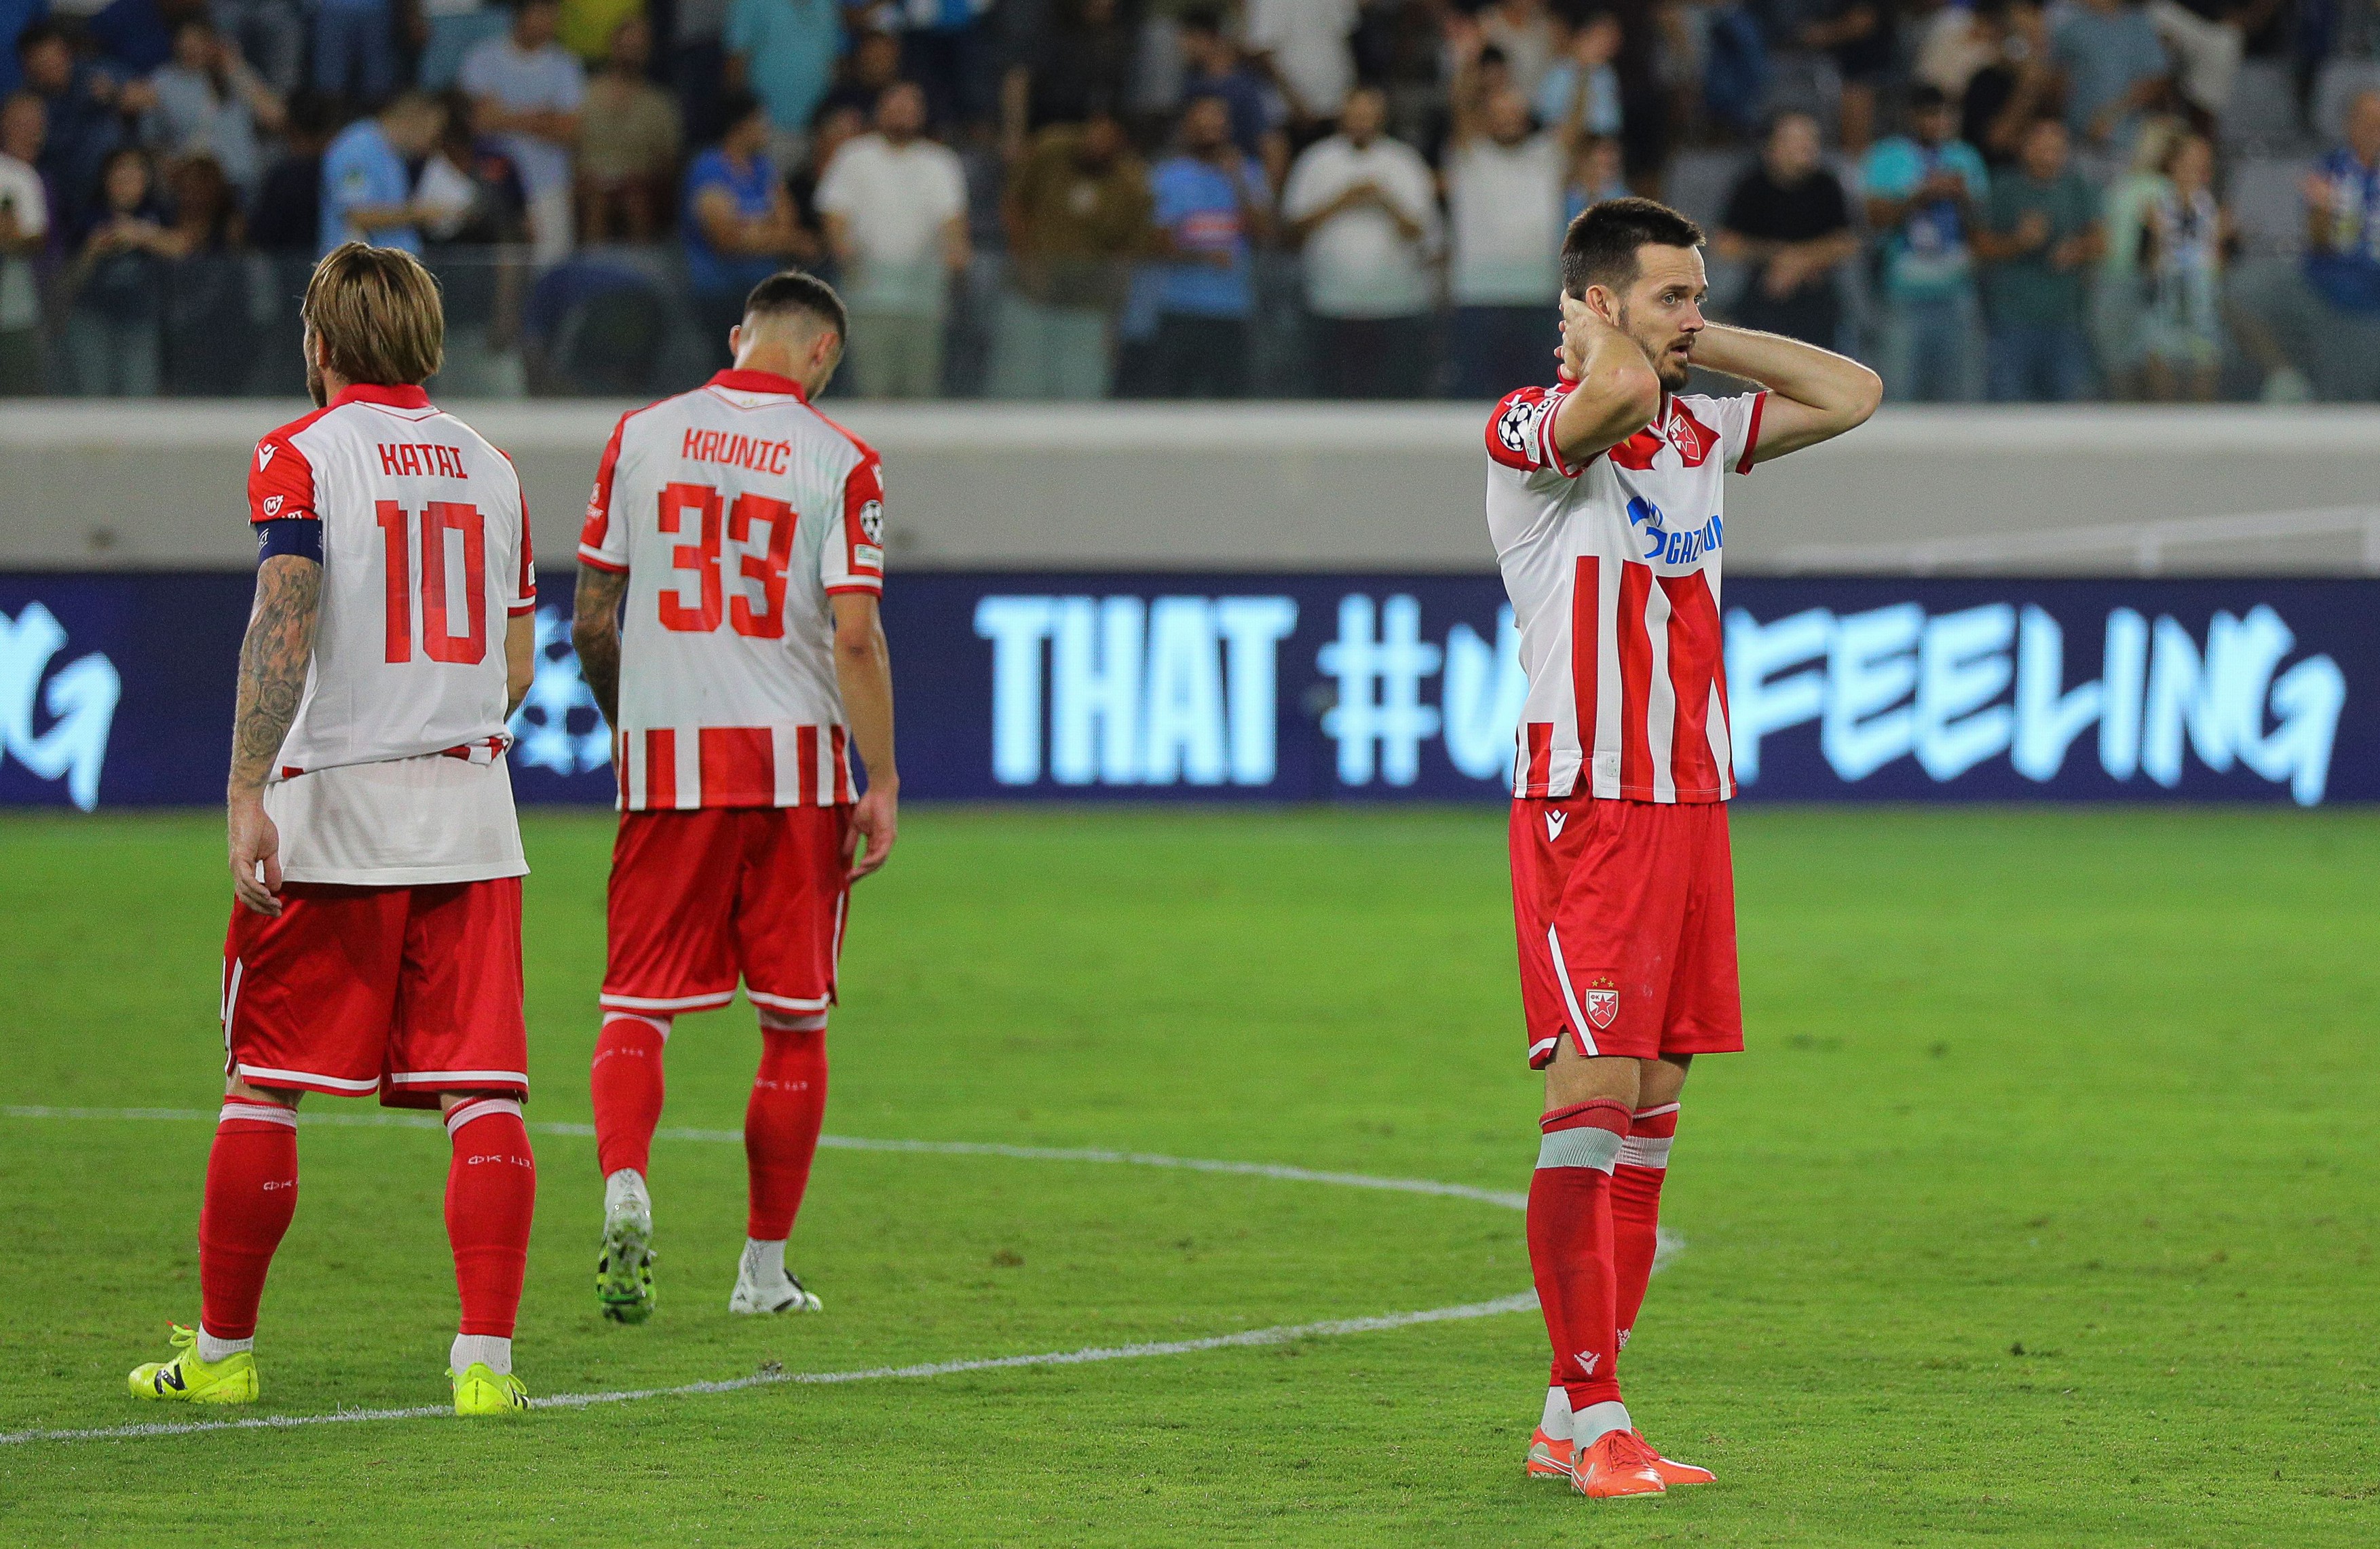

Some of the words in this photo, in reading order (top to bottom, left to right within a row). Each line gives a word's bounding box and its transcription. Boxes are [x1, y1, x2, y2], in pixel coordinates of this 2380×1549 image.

[377, 443, 468, 479] KATAI
[681, 427, 792, 476] KRUNIĆ
[375, 499, 487, 665] 10
[658, 482, 799, 640] 33
[973, 595, 1299, 786] THAT
